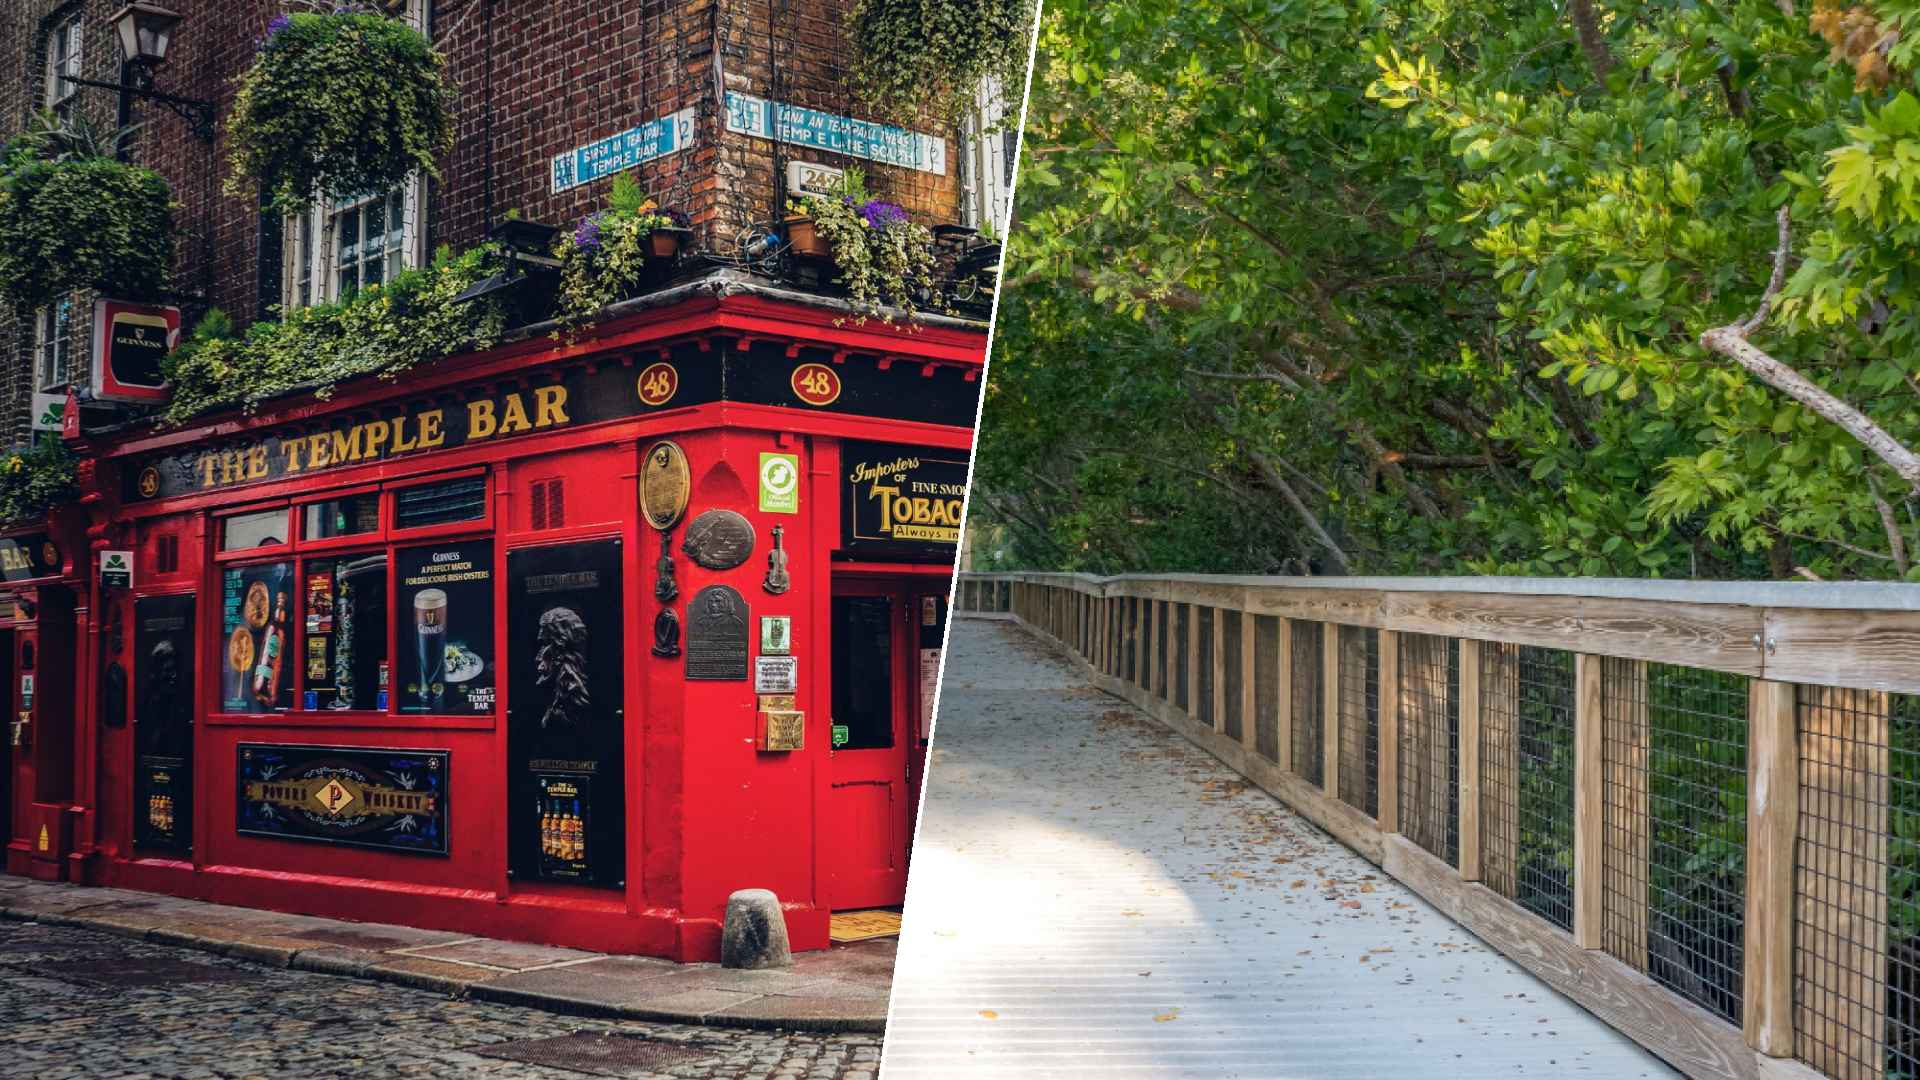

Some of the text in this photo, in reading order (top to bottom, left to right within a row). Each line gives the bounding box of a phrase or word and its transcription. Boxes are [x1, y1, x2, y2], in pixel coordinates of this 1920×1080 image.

[680, 120, 689, 139] 2
[808, 115, 823, 128] AN
[777, 124, 826, 144] TEMPE
[592, 142, 658, 175] TEMPLE BAR
[644, 370, 670, 398] 48
[801, 368, 830, 395] 48
[198, 384, 570, 487] THE TEMPLE BAR
[849, 457, 920, 485] Importers
[894, 474, 907, 483] OF
[912, 482, 938, 494] FINE
[896, 526, 959, 539] Always in
[0, 546, 35, 571] BAR
[433, 552, 460, 562] GUINNESS
[427, 564, 450, 573] PERFECT
[451, 562, 472, 570] MATCH
[464, 571, 490, 580] OYSTERS
[467, 694, 496, 702] TEMPLE
[474, 702, 489, 710] BAR
[328, 784, 343, 810] P
[362, 791, 421, 810] WHISKEY
